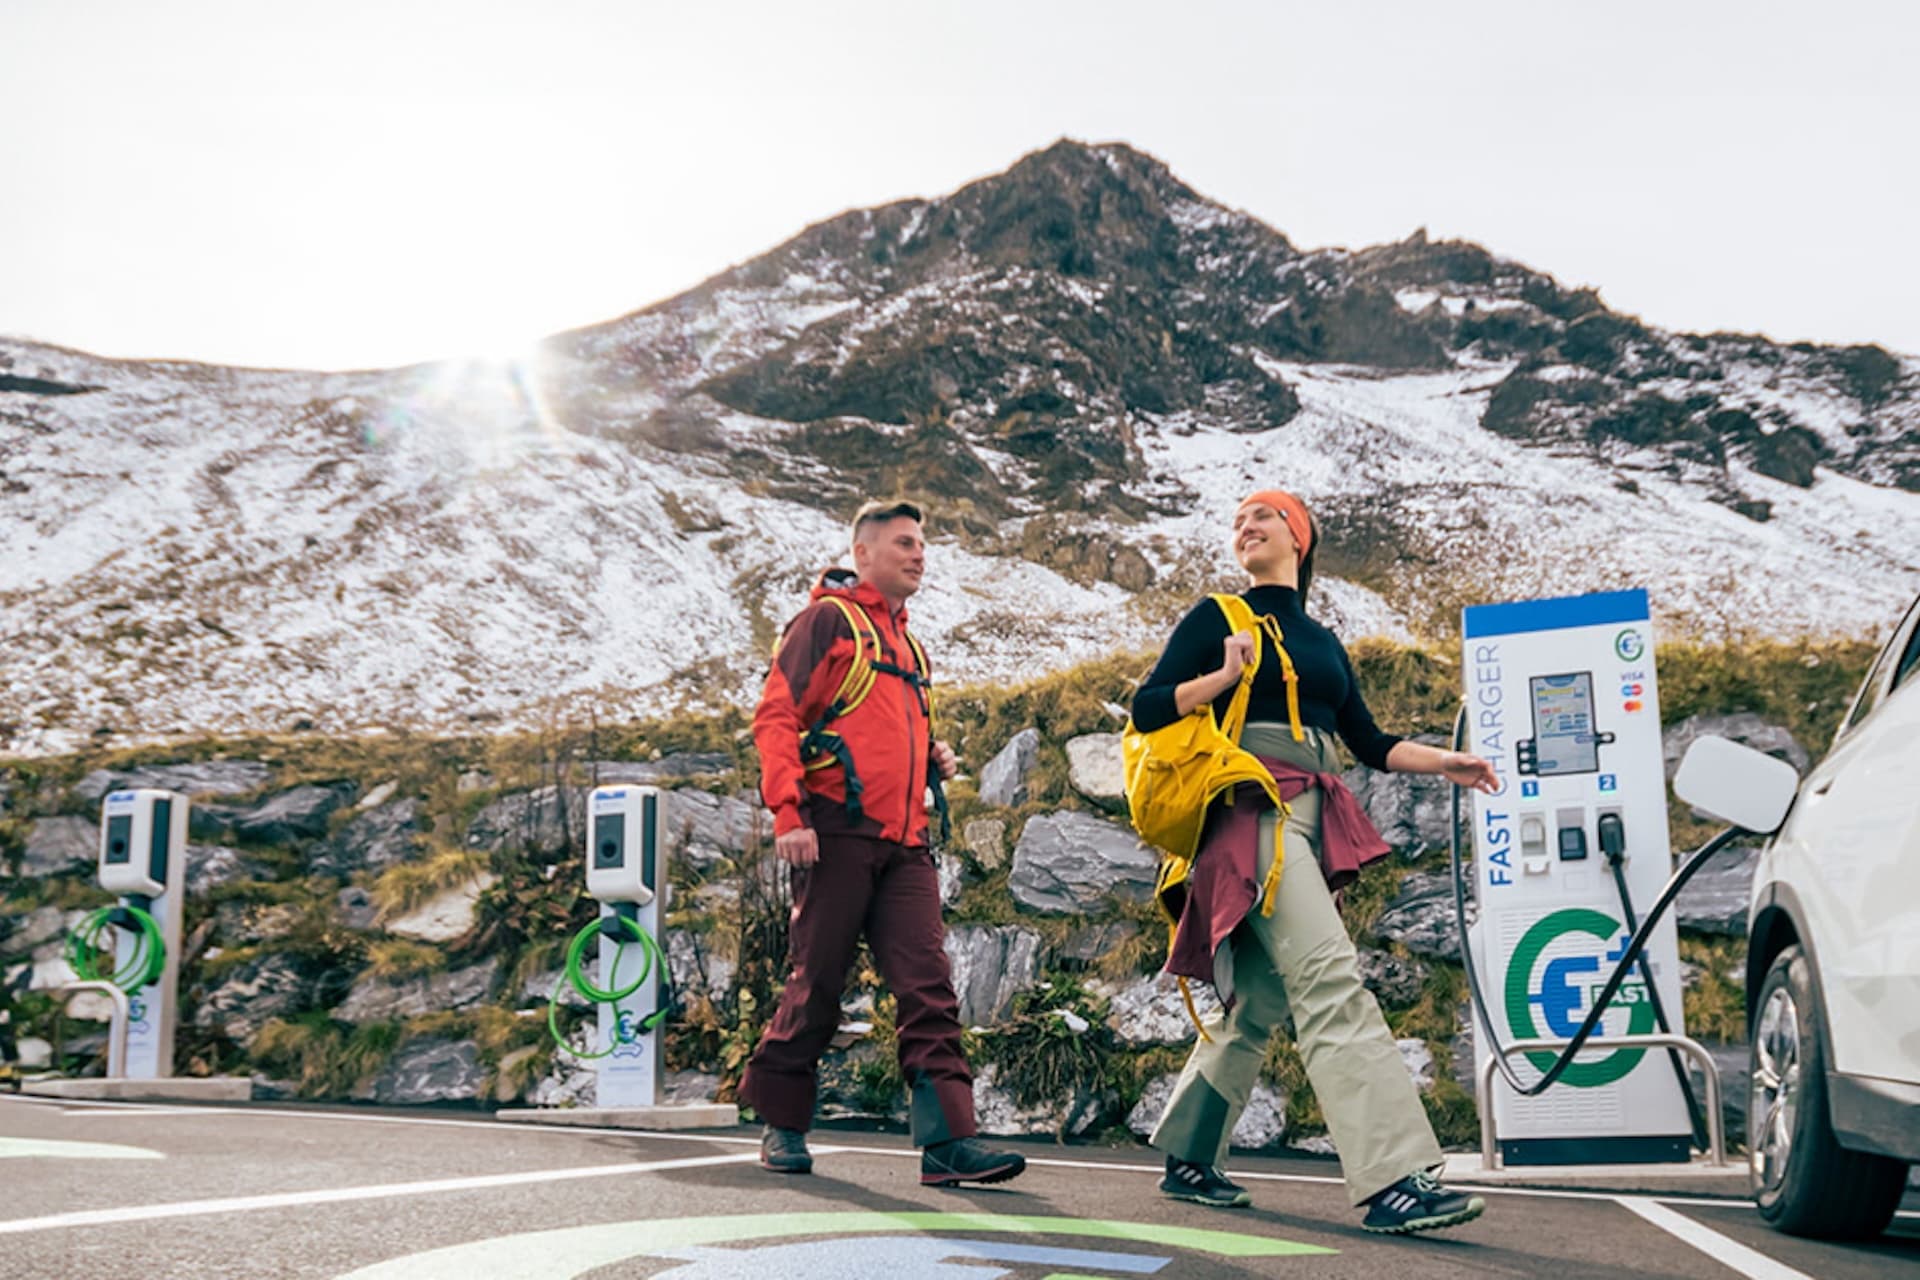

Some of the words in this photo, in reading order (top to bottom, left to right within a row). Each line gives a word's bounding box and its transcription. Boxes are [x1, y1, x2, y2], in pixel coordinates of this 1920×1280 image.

[1476, 644, 1508, 797] CHARGER
[1602, 776, 1613, 789] 2
[1487, 809, 1512, 886] FAST
